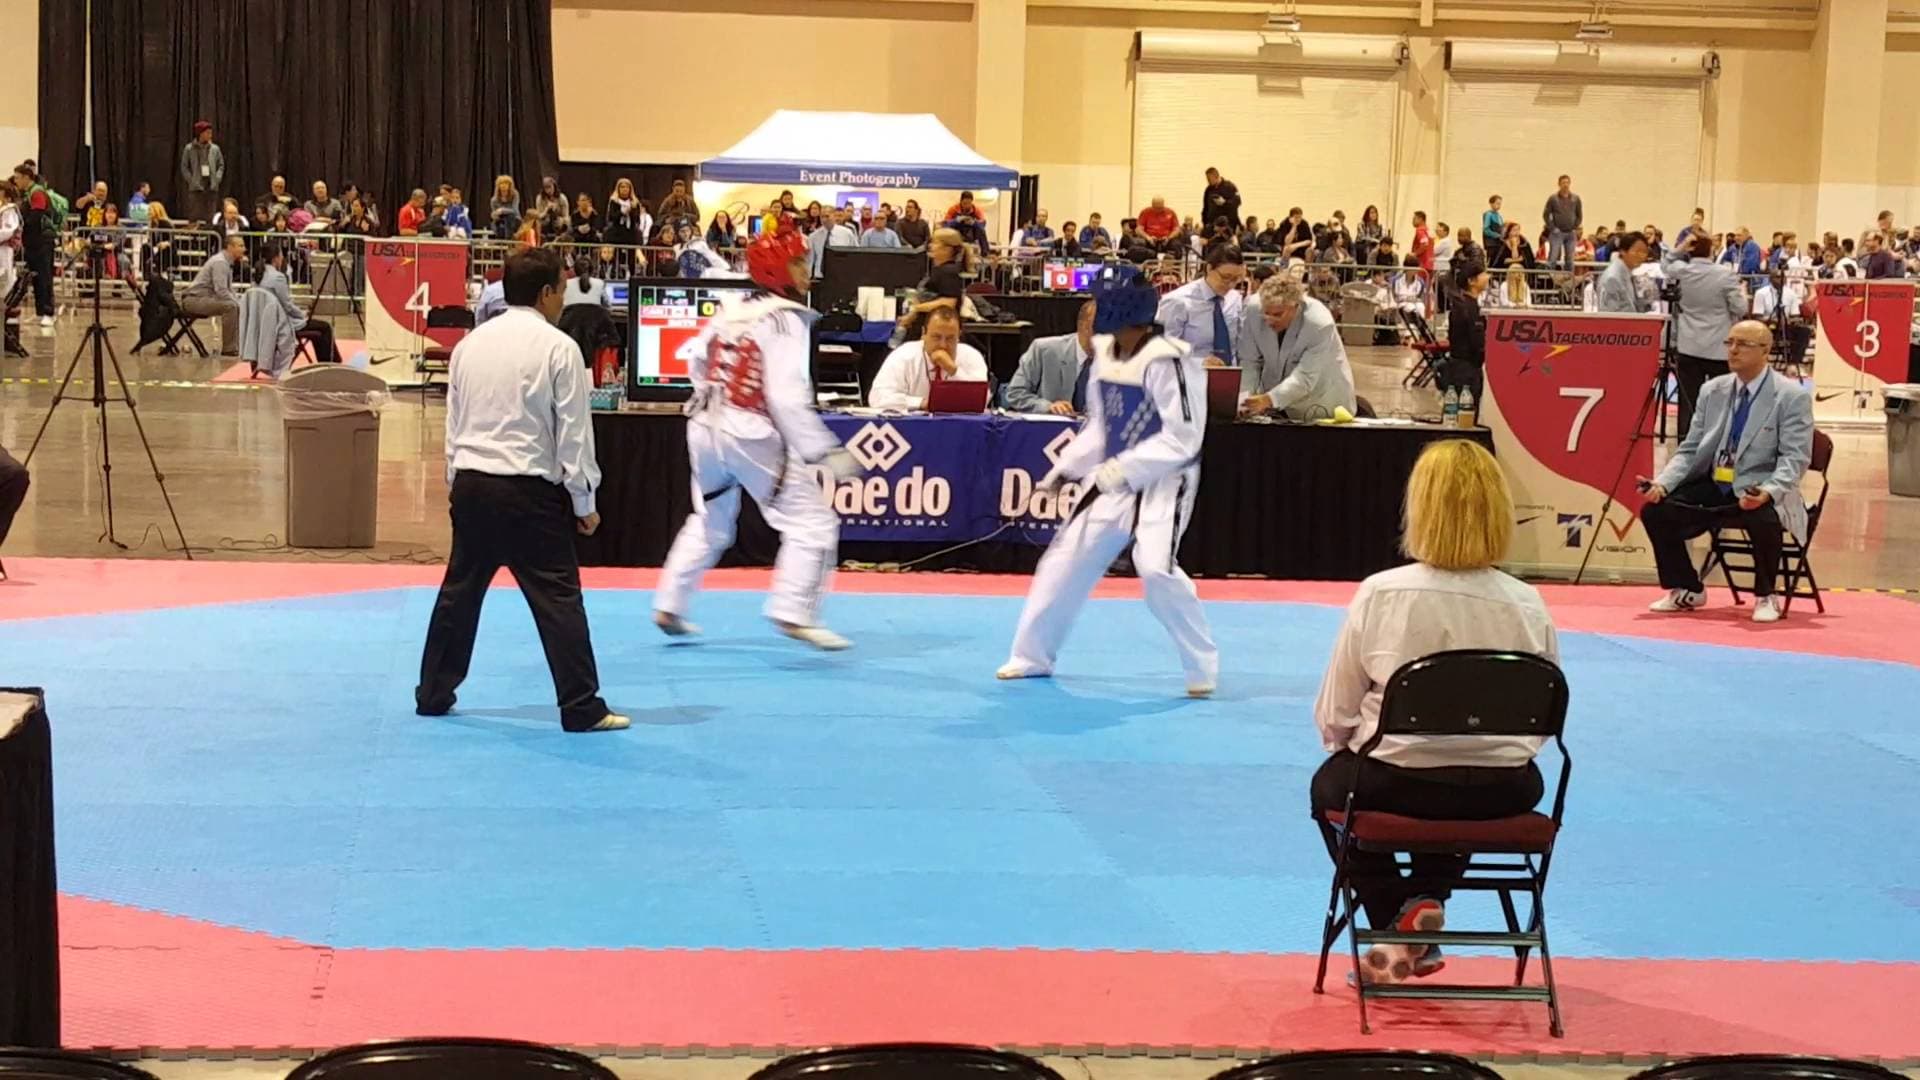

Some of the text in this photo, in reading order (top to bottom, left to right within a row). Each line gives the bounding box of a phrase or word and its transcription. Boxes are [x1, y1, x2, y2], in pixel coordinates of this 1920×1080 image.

[800, 170, 920, 187] Event Photography
[372, 243, 405, 257] USA
[405, 282, 432, 319] 4
[1824, 284, 1855, 297] USA
[1495, 319, 1652, 346] USA TAEKWONDO
[1854, 320, 1880, 358] 3
[1559, 387, 1605, 452] 7
[840, 518, 949, 527] RNATIONAL
